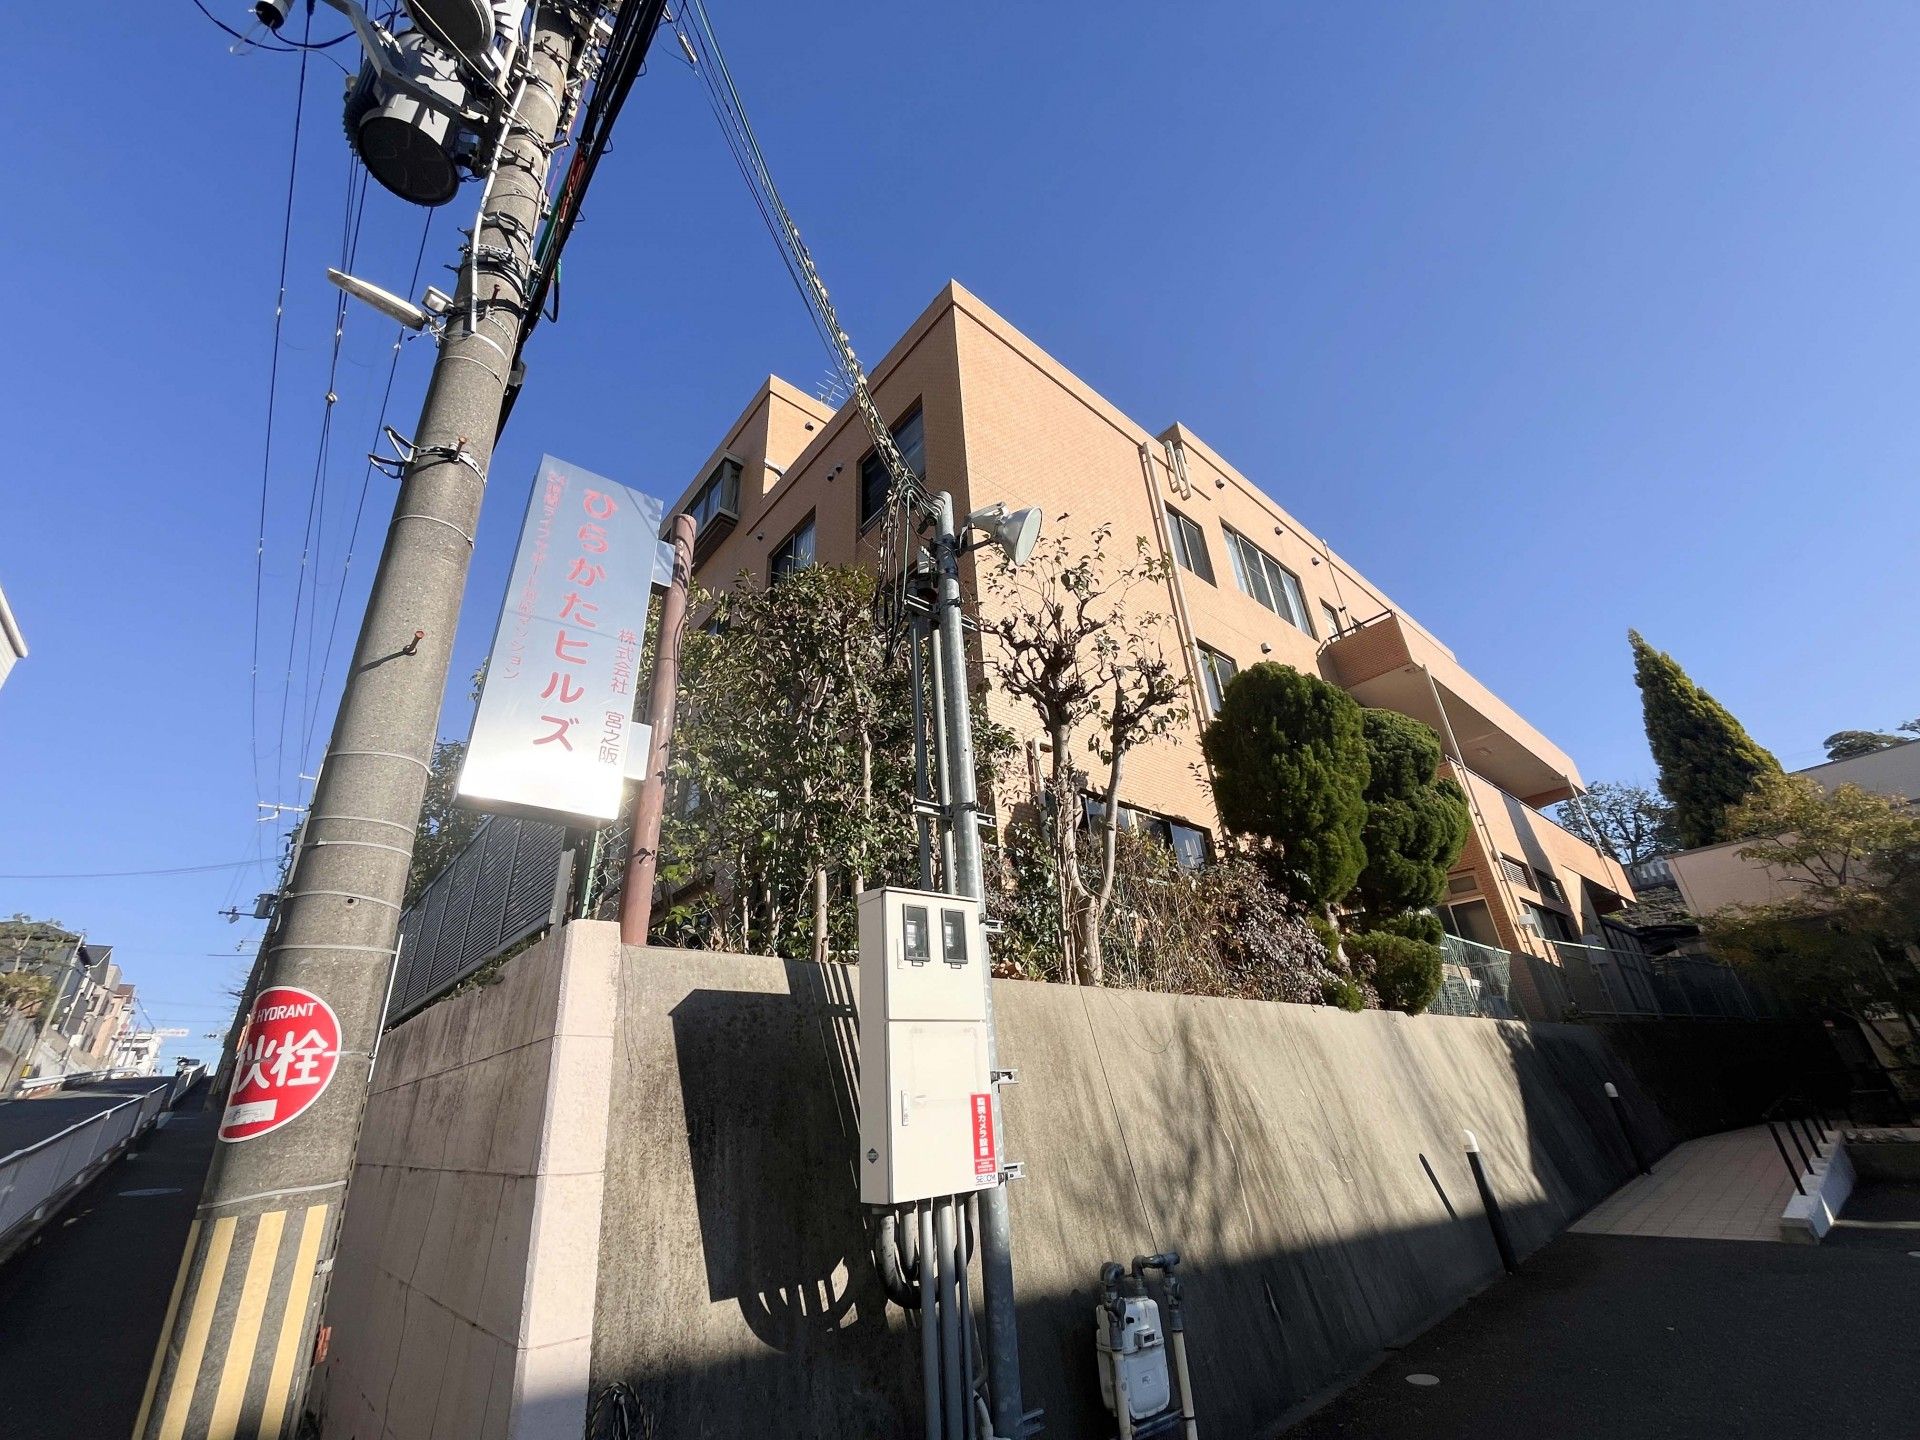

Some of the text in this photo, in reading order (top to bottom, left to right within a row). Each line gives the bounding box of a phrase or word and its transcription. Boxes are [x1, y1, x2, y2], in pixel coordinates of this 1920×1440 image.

[533, 486, 619, 753] ひらかたヒルズ
[598, 627, 638, 767] 株式会社 宮之阪
